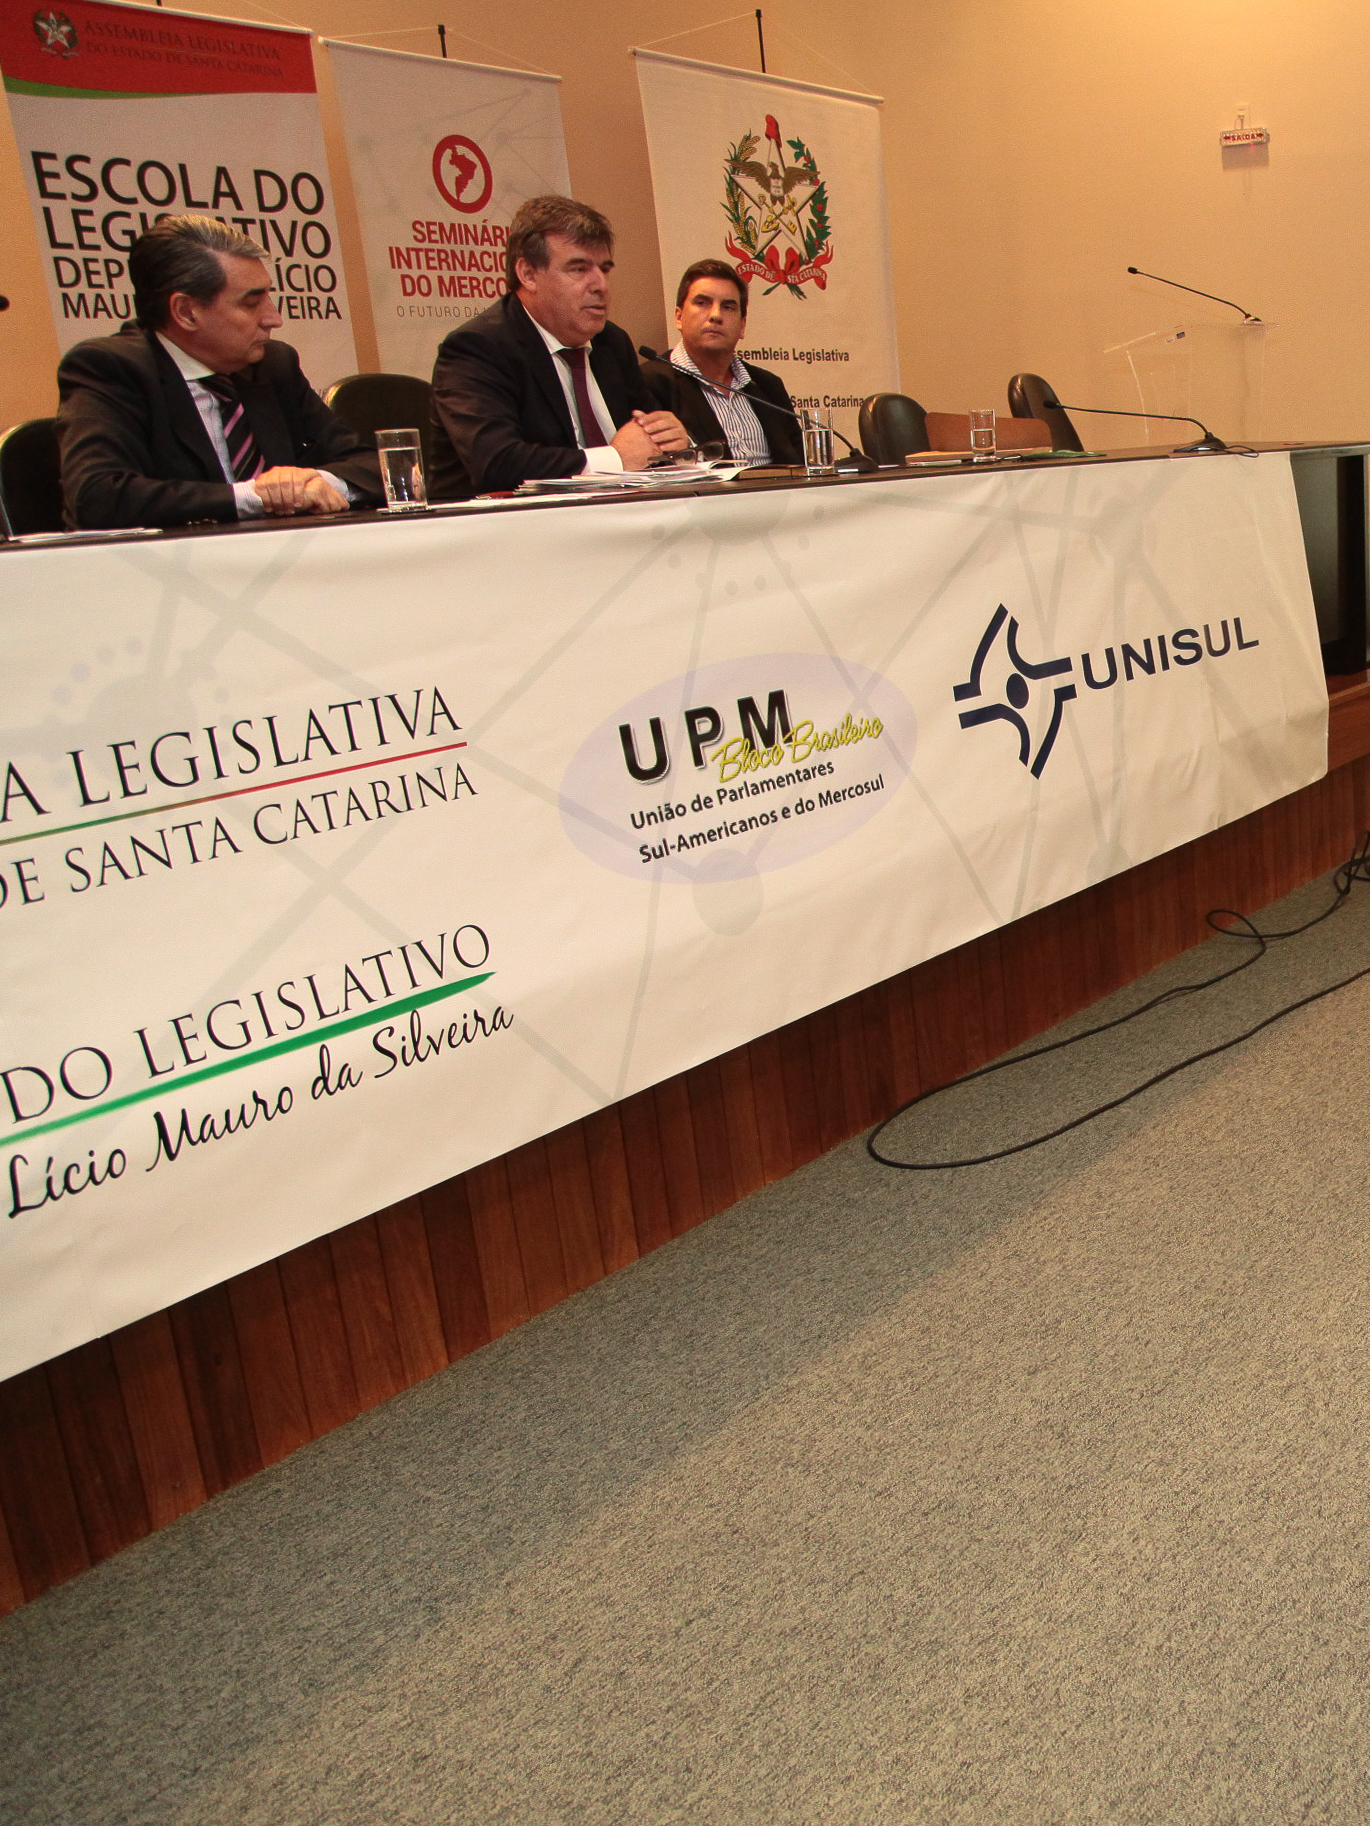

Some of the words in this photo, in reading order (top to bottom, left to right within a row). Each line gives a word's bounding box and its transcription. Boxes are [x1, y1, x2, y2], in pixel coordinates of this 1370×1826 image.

[188, 35, 281, 60] LEGISLATIVA
[31, 150, 243, 211] ESCOLA
[253, 169, 325, 216] DO
[42, 206, 332, 260] LEGITIVO
[388, 246, 507, 273] INTERNACIO
[412, 219, 510, 248] SEMINÁRI
[270, 257, 337, 293] ÍCIO
[400, 274, 432, 298] DO
[437, 275, 508, 299] MERCO
[62, 292, 135, 320] MAU
[397, 305, 405, 317] O
[409, 305, 461, 318] FUTURO
[465, 306, 480, 318] DA
[737, 347, 790, 361] sembleia
[793, 348, 850, 364] Legislativa
[791, 395, 820, 409] Santa
[823, 395, 864, 409] Catarina
[1081, 617, 1259, 690] UNISUL
[66, 686, 463, 807] LEGISLATIVA
[619, 689, 795, 785] UPM
[710, 736, 785, 783] Bloco
[783, 712, 884, 763] Brasileiro
[630, 800, 687, 830] União
[691, 794, 714, 813] de
[716, 760, 835, 806] Parlamentares
[639, 811, 778, 864] Sul-Americanos
[781, 806, 791, 819] e
[794, 798, 816, 816] do
[818, 774, 885, 808] Mercosul
[0, 858, 45, 908] E
[65, 817, 243, 893] SANTA
[254, 763, 479, 845] CATARINA
[0, 1046, 113, 1123] DO
[133, 924, 490, 1078] LEGISLATIVO
[8, 1148, 127, 1219] Lício
[145, 1085, 294, 1172] Mauro
[311, 1044, 364, 1100] da
[372, 1004, 515, 1079] Silveira
